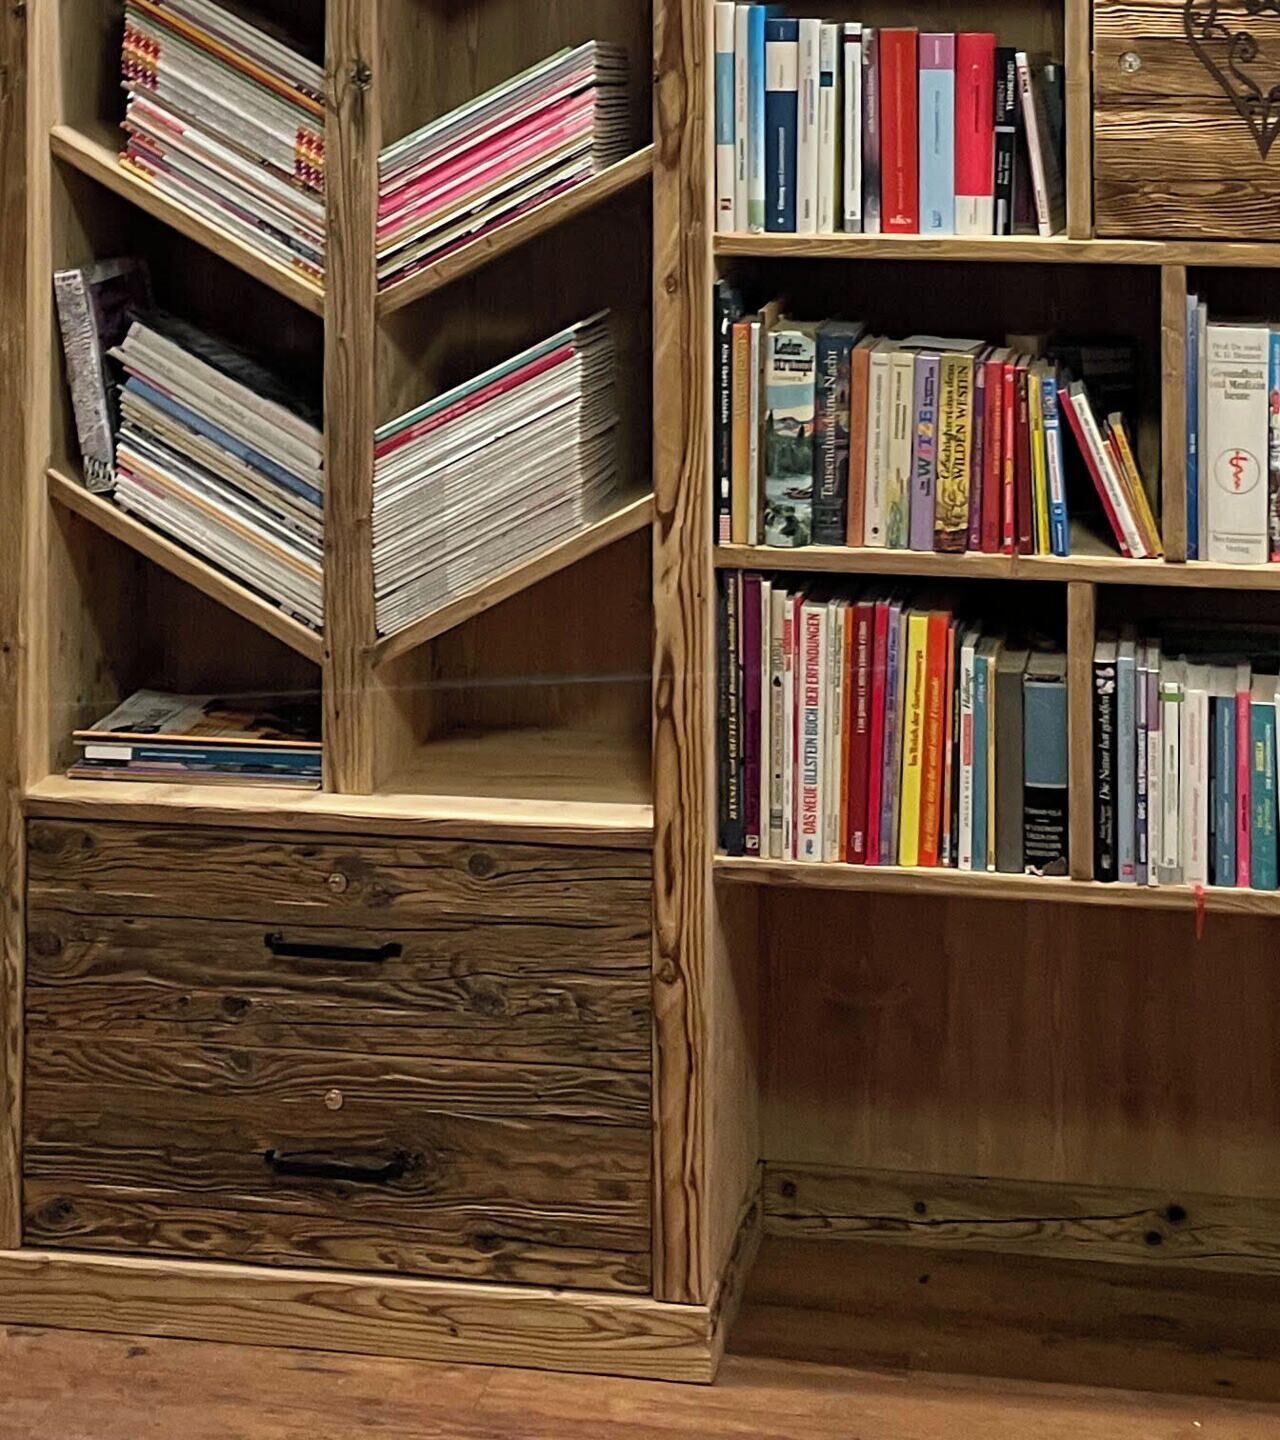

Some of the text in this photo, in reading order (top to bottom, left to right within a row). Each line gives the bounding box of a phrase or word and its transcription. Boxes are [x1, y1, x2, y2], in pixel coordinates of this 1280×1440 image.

[821, 350, 839, 498] Tausendundeine Nacht
[918, 411, 934, 477] WITZE
[953, 365, 968, 479] WILDEN WESTEN
[807, 614, 821, 684] ERFINDUNGEN
[807, 686, 820, 706] DER
[806, 708, 819, 736] BUCH
[804, 786, 818, 812] NEUE
[803, 814, 816, 835] DAS
